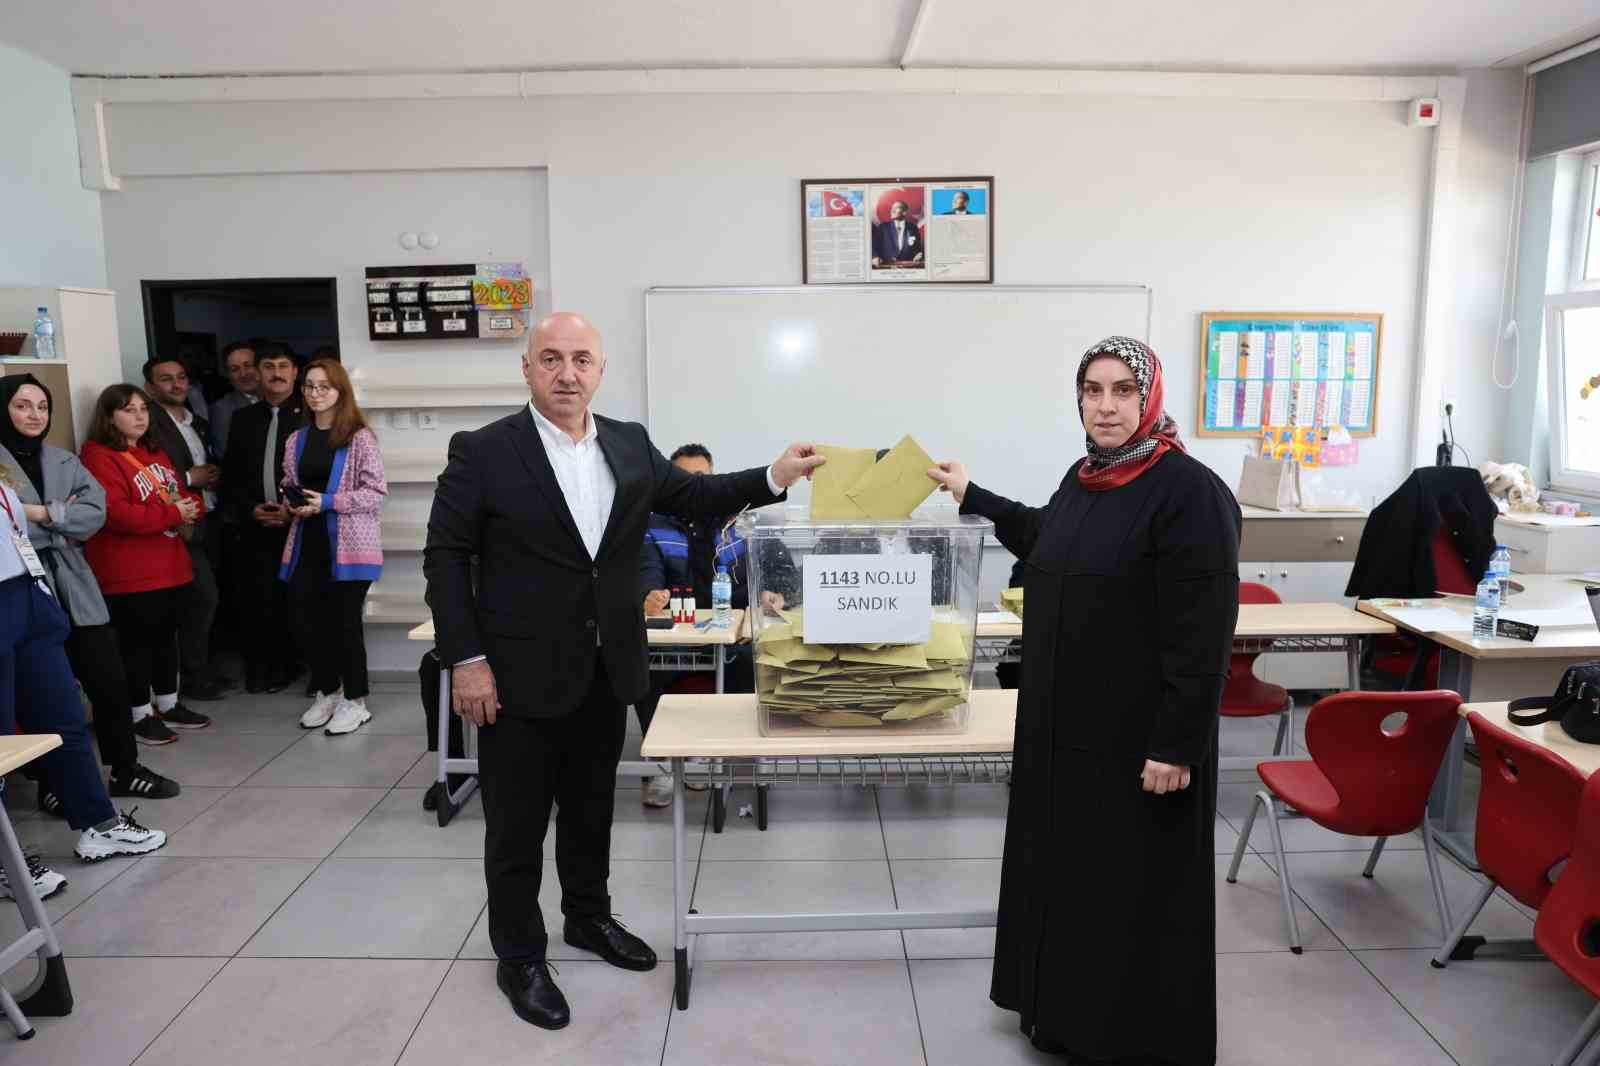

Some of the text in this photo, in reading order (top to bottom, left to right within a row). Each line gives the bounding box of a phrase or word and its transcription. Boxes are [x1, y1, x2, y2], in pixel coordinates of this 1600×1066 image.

[474, 280, 529, 305] 2023
[820, 571, 916, 588] 1143 NO.LU
[837, 596, 898, 610] SANDIK
